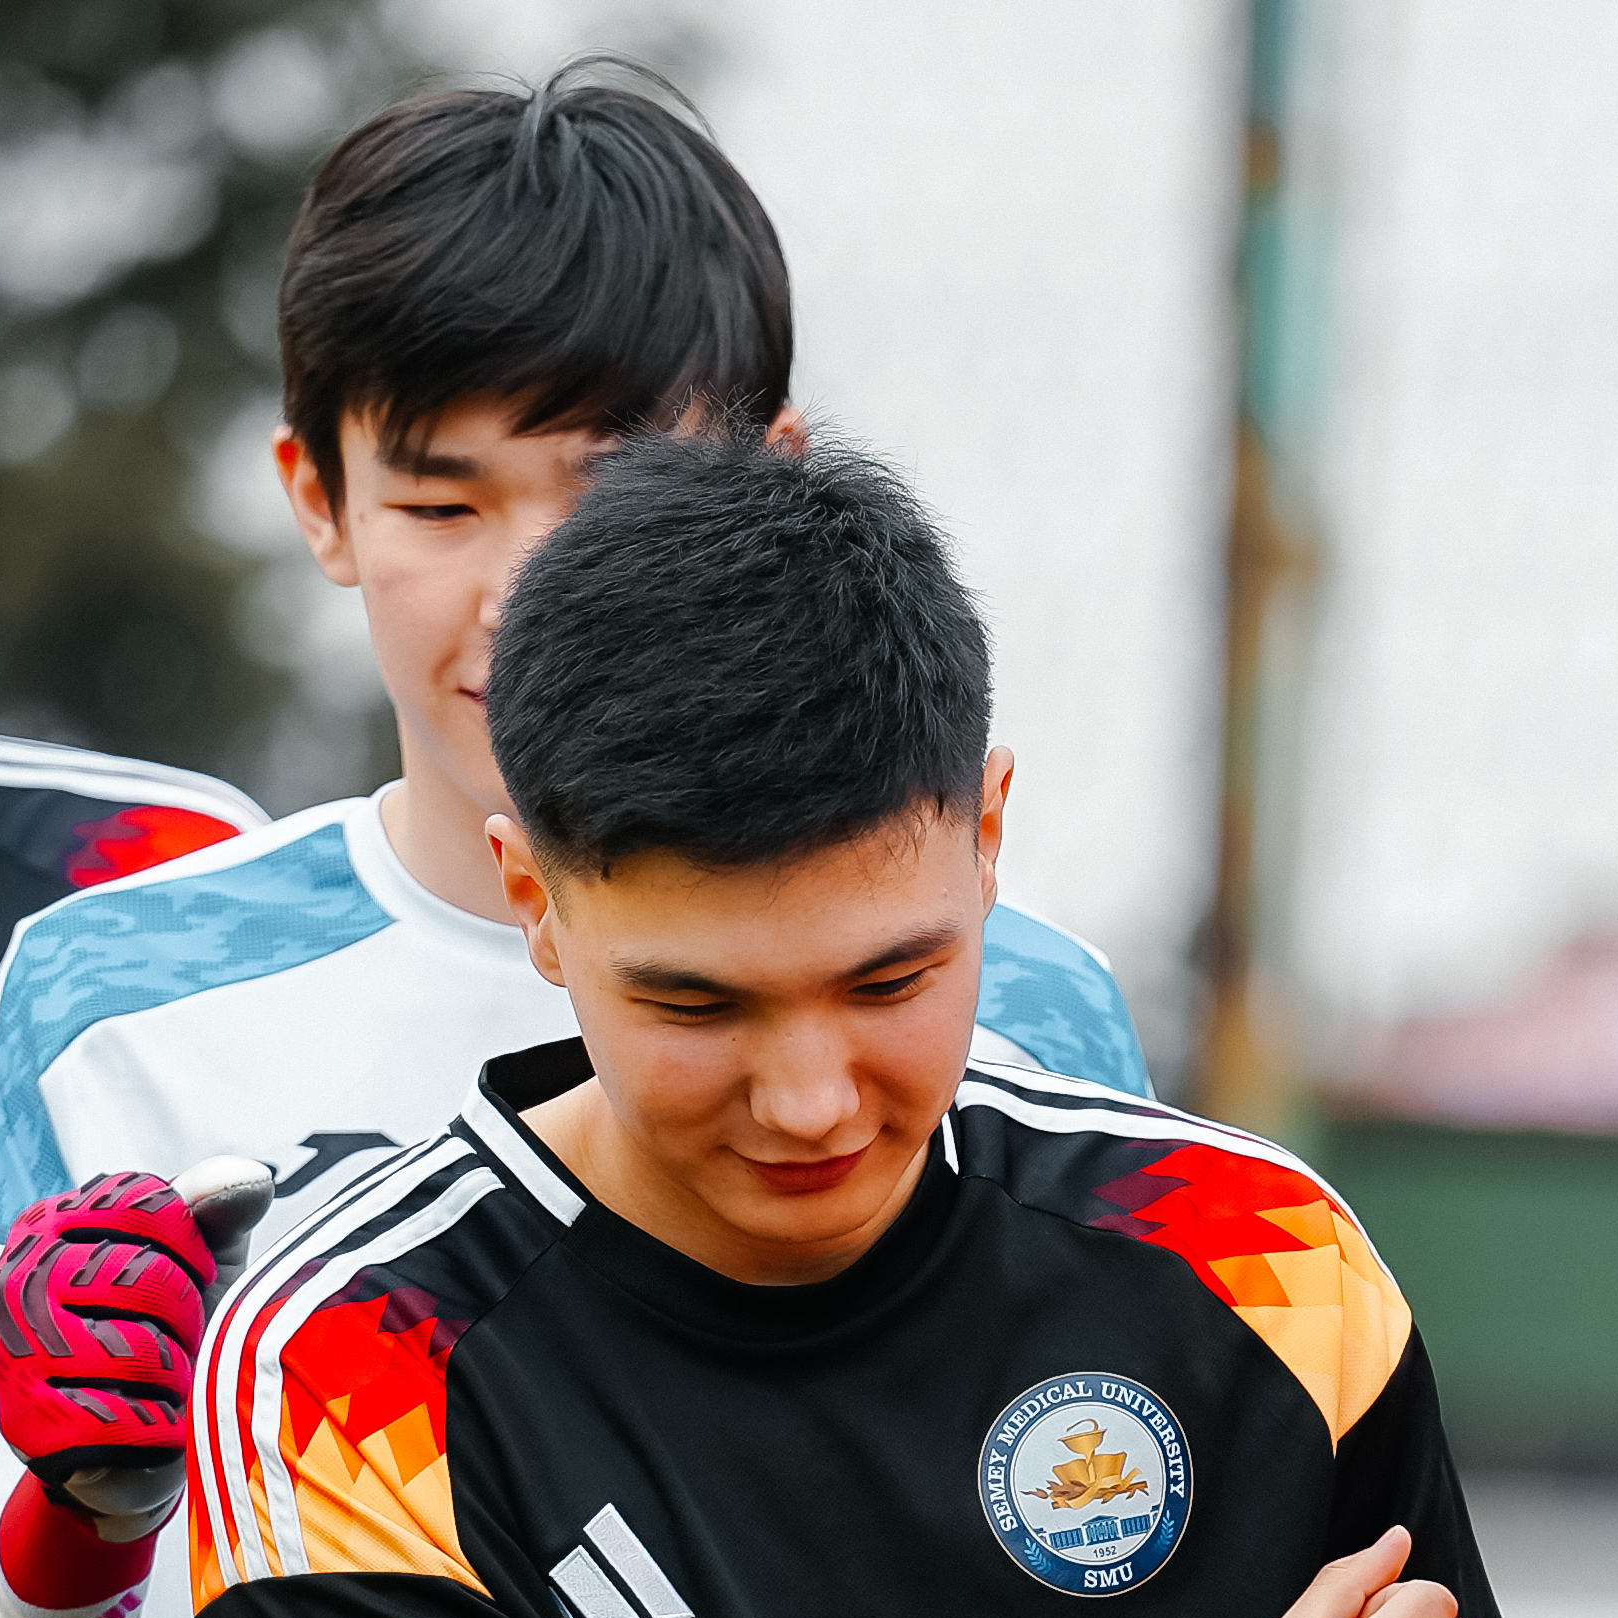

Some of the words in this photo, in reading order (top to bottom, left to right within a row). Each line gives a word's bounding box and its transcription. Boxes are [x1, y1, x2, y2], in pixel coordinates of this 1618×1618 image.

[997, 1381, 1093, 1447] MEDICAL
[1100, 1381, 1185, 1499] UNIVERSITY
[987, 1448, 1018, 1532] SEMEY
[1084, 1562, 1133, 1588] SMU
[1093, 1545, 1117, 1558] 1952
